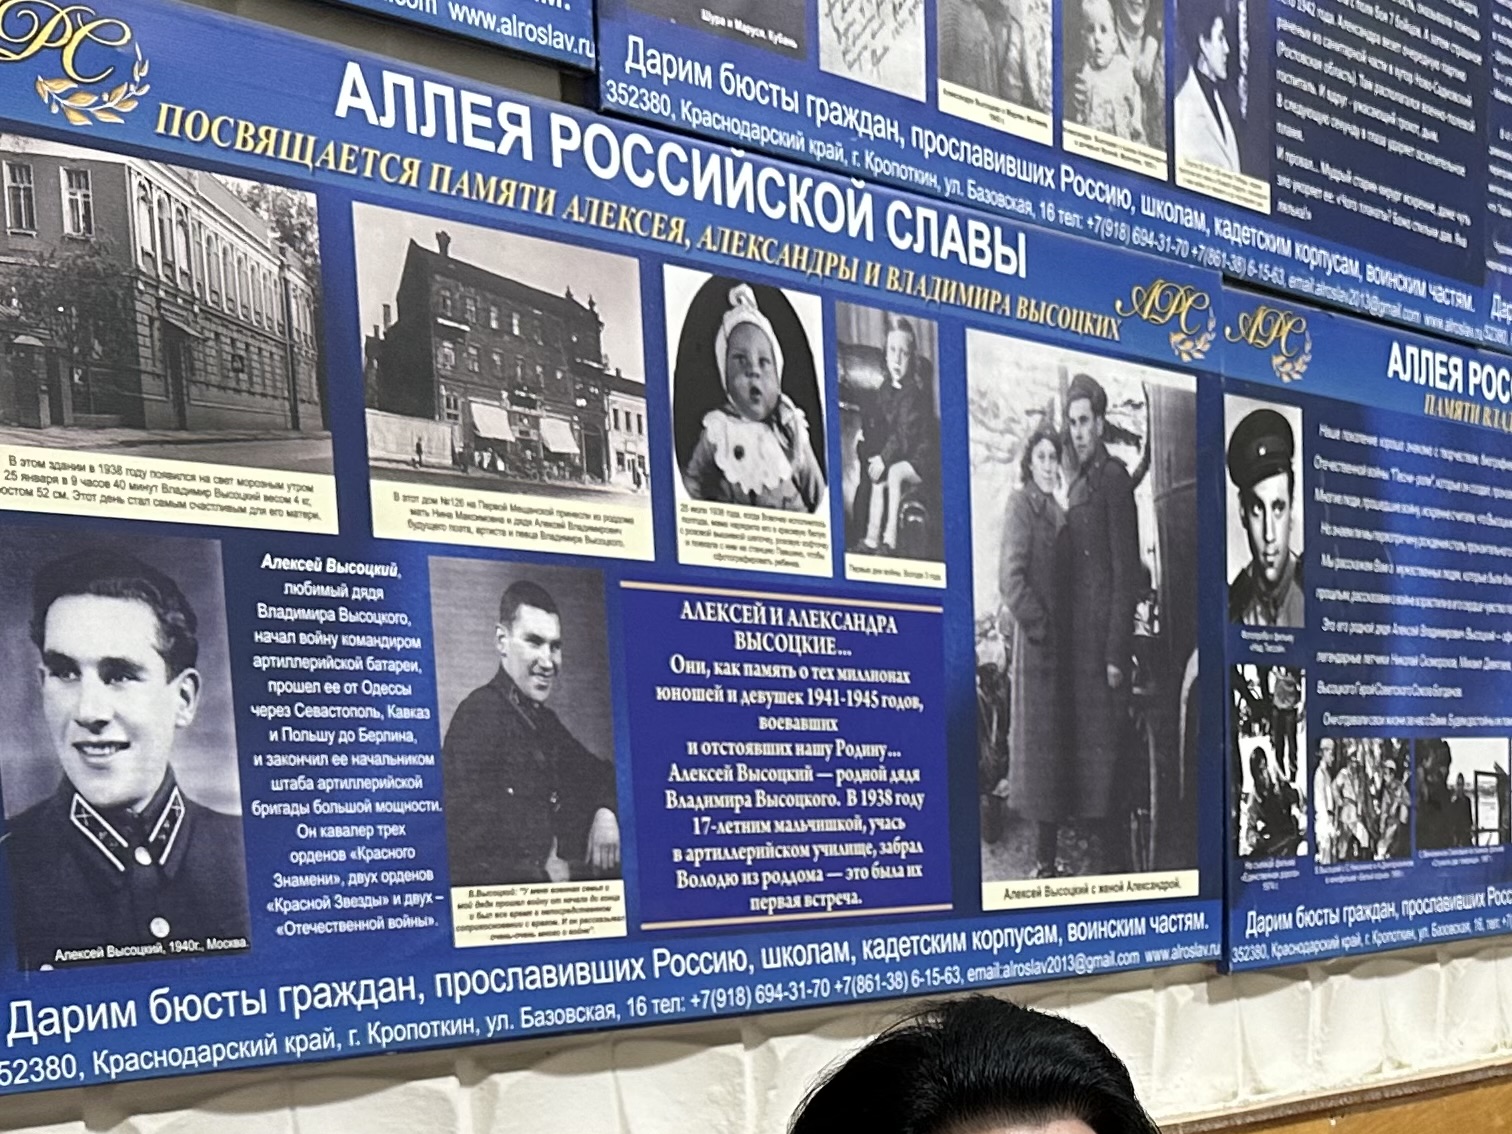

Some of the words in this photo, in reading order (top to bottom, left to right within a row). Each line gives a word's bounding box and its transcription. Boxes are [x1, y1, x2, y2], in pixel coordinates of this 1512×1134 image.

[0, 0, 132, 83] РС
[448, 2, 595, 58] www.alroslav.ru
[335, 61, 533, 161] АЛЛЕЯ
[551, 112, 874, 243] РОССИЙСКОЙ
[886, 200, 1027, 278] СЛАВЫ
[625, 34, 712, 90] Дарим
[720, 63, 799, 114] бюсты
[806, 92, 904, 149] граждан,
[911, 125, 1055, 190] прославивших
[1061, 164, 1136, 215] Россию,
[1140, 195, 1210, 237] школам,
[1214, 219, 1292, 260] кадетским
[1294, 240, 1363, 283] корпусам,
[1366, 264, 1427, 299] воинским
[1428, 284, 1476, 313] частям.
[155, 102, 422, 188] ПОСВЯЩАЕТСЯ
[428, 162, 556, 217] ПАМЯТИ
[562, 195, 691, 250] АЛЕКСЕЯ,
[697, 226, 859, 282] АЛЕКСАНДРЫ
[864, 262, 881, 287] И
[885, 265, 1011, 315] ВЛАДИМИРА
[1016, 301, 1124, 341] ВЫСОЦКИХ
[1387, 341, 1463, 392] АЛЛЕЯ
[1424, 394, 1480, 425] ПАМЯТИ
[261, 553, 322, 572] Алексей
[326, 558, 402, 579] Высоцкий,
[284, 581, 349, 598] любимый
[351, 587, 384, 601] дядя
[257, 603, 336, 624] Владимира
[338, 607, 412, 626] Высоцкого,
[680, 600, 767, 626] АЛЕКСЕЙ
[770, 608, 783, 626] И
[787, 608, 898, 636] АЛЕКСАНДРА
[254, 630, 296, 644] начал
[299, 631, 338, 649] войну
[341, 635, 421, 651] командиром
[734, 630, 852, 657] ВЫСОЦКИЕ...
[253, 655, 363, 672] артиллерийской
[366, 657, 422, 674] батареи,
[670, 653, 711, 679] Они,
[713, 661, 740, 676] как
[743, 662, 796, 680] память
[799, 666, 809, 680] о
[812, 666, 834, 681] тех
[837, 668, 911, 684] миллионах
[268, 681, 321, 696] прошел
[324, 683, 340, 694] ее
[343, 684, 358, 694] от
[361, 680, 412, 697] Одессы
[656, 685, 724, 703] юношей
[727, 688, 737, 703] и
[741, 690, 803, 709] девушек
[807, 687, 879, 708] 1941-1945
[881, 693, 924, 712] годов,
[273, 872, 345, 888] Знамени»,
[348, 872, 378, 887] двух
[381, 869, 434, 886] орденов
[1003, 887, 1042, 901] Алексей
[1044, 884, 1089, 899] Высоцкий
[1091, 885, 1096, 894] с
[1098, 881, 1124, 894] женой
[1126, 878, 1181, 893] Александрой.
[276, 916, 384, 936] «Отечественной
[387, 914, 439, 930] войны».
[1245, 910, 1292, 938] Дарим
[1296, 904, 1339, 928] бюсты
[1343, 900, 1399, 927] граждан,
[1401, 891, 1485, 920] прославивших
[55, 946, 104, 962] Алексей
[106, 942, 167, 959] Высоцкий,
[168, 940, 205, 954] 1940г.,
[207, 937, 249, 951] Москва.
[7, 999, 137, 1047] Дарим
[150, 987, 267, 1025] бюсты
[279, 974, 424, 1019] граждан,
[435, 957, 645, 1003] прославивших
[653, 948, 755, 979] Россию,
[761, 941, 856, 969] школам,
[862, 932, 966, 963] кадетским
[972, 924, 1063, 954] корпусам,
[1067, 917, 1146, 942] воинским
[1150, 912, 1209, 934] частям.
[93, 1032, 278, 1080] Краснодарский
[285, 1027, 342, 1058] край,
[349, 1028, 361, 1046] г.
[368, 1015, 480, 1048] Кропоткин,
[486, 1013, 514, 1037] ул.
[520, 1002, 621, 1028] Базовская,
[627, 995, 647, 1017] 16
[652, 995, 686, 1015] тел:
[691, 985, 751, 1013] +7(918)
[755, 979, 830, 1004] 694-31-70
[834, 971, 909, 998] +7(861-38)
[911, 965, 964, 988] 6-15-63,
[1145, 943, 1221, 964] www.alroslav.ru
